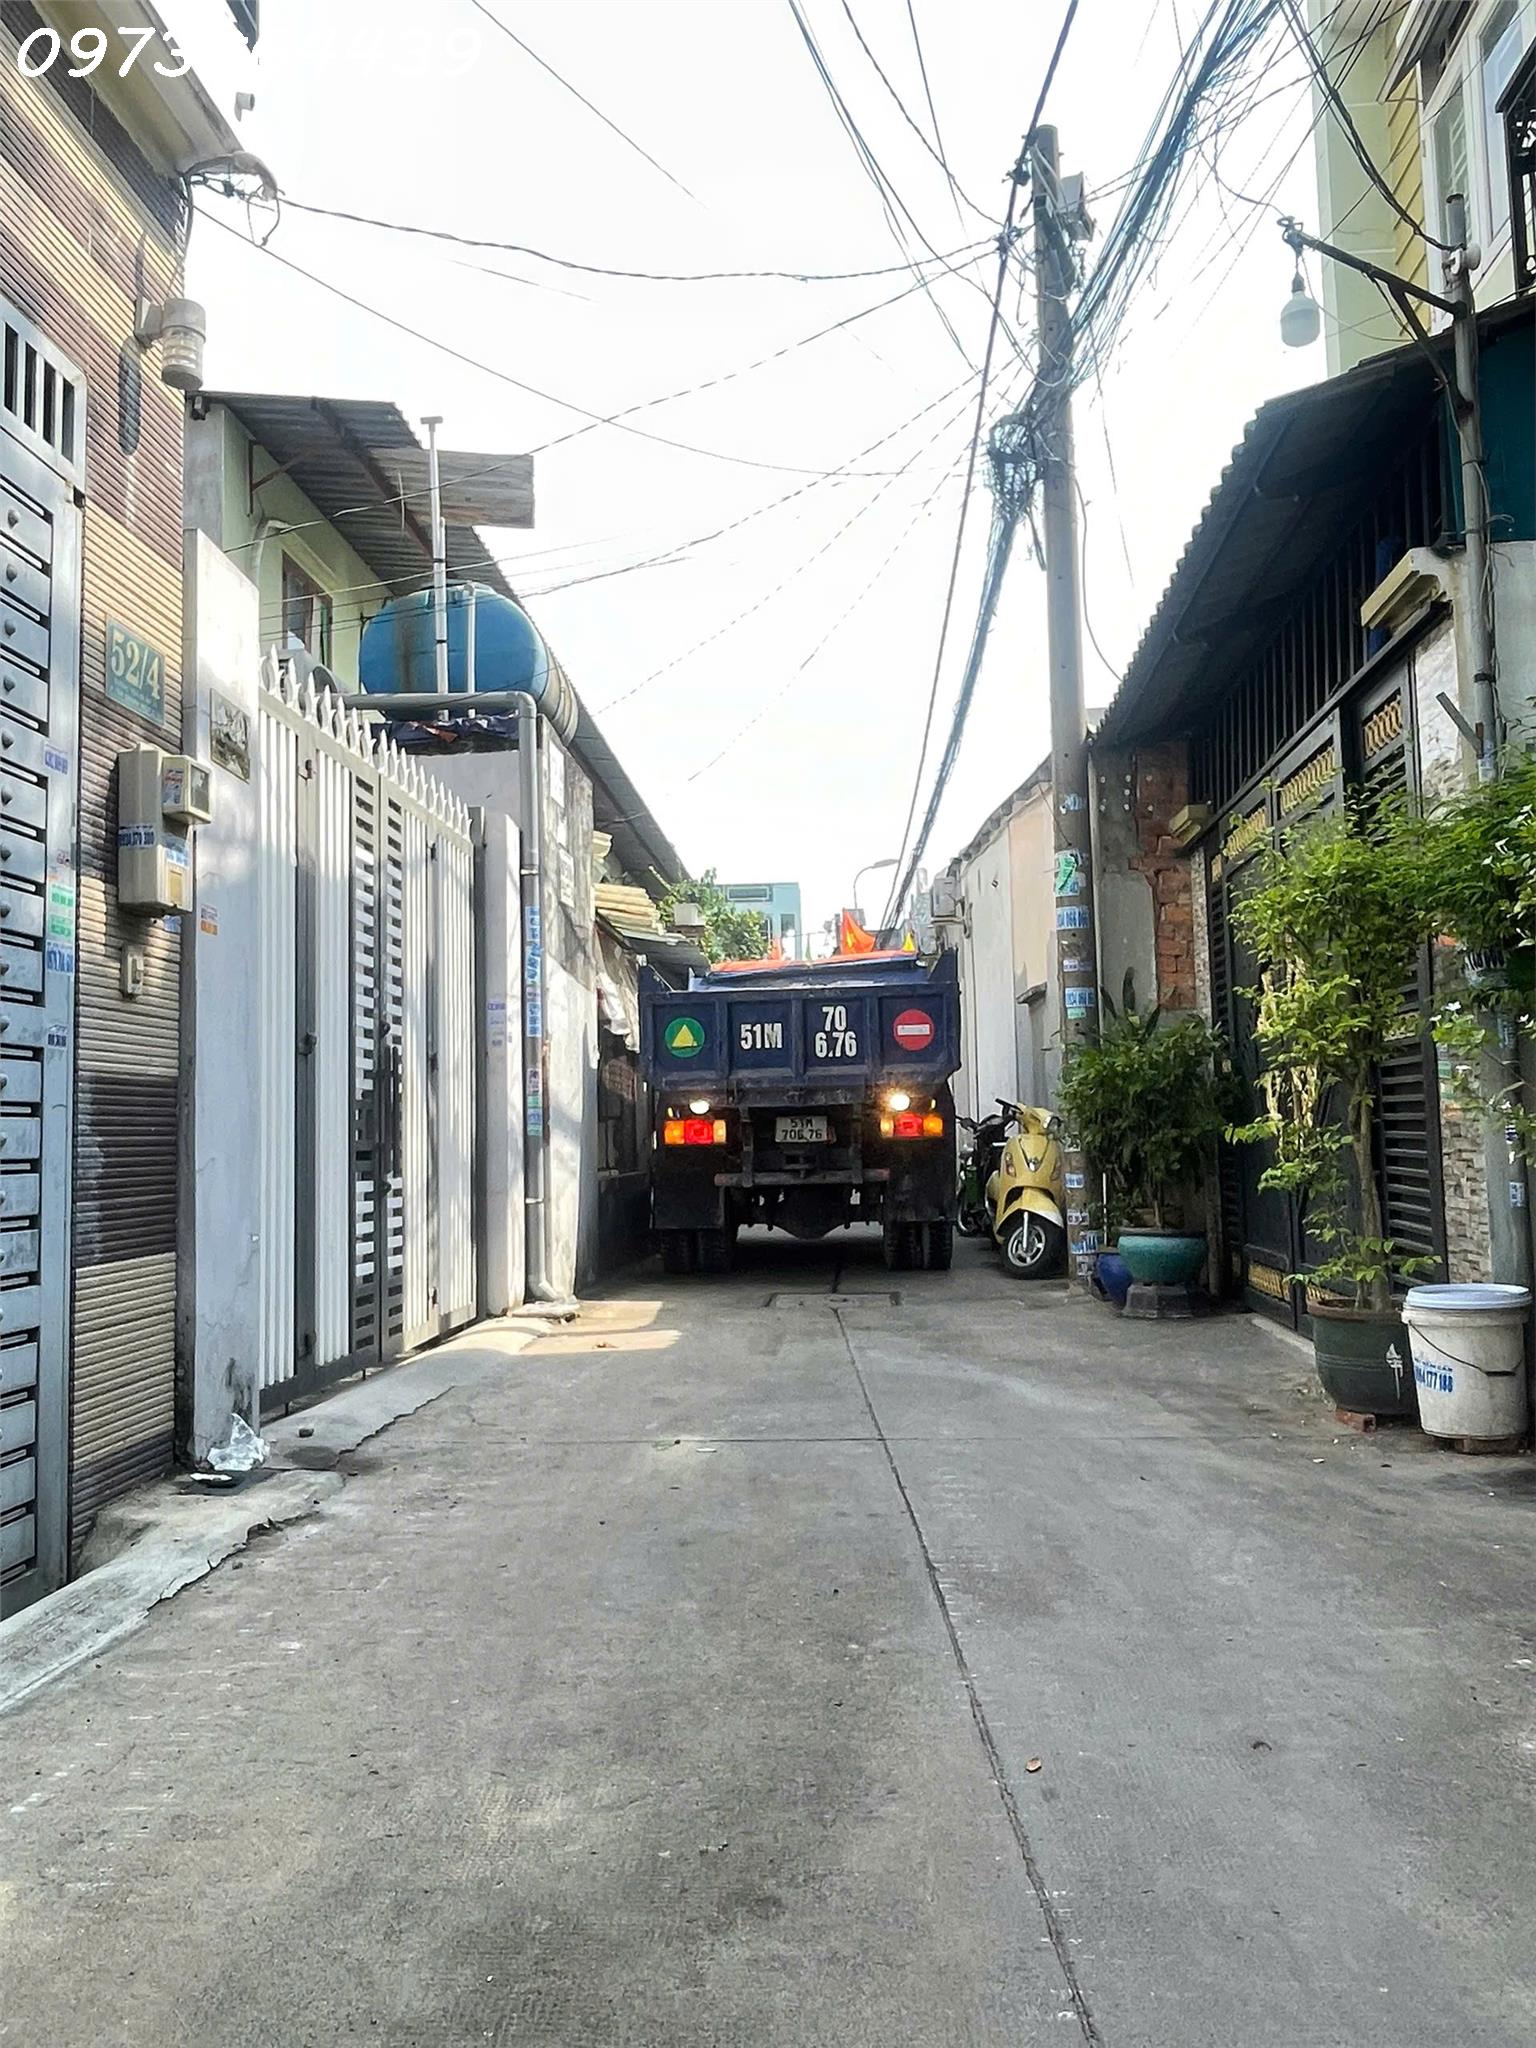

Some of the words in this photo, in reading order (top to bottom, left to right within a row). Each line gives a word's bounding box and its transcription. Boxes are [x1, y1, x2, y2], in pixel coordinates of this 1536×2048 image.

[111, 628, 160, 700] 52/4
[822, 1005, 846, 1031] 70
[740, 1022, 783, 1049] 51M
[814, 1031, 857, 1058] 6.76
